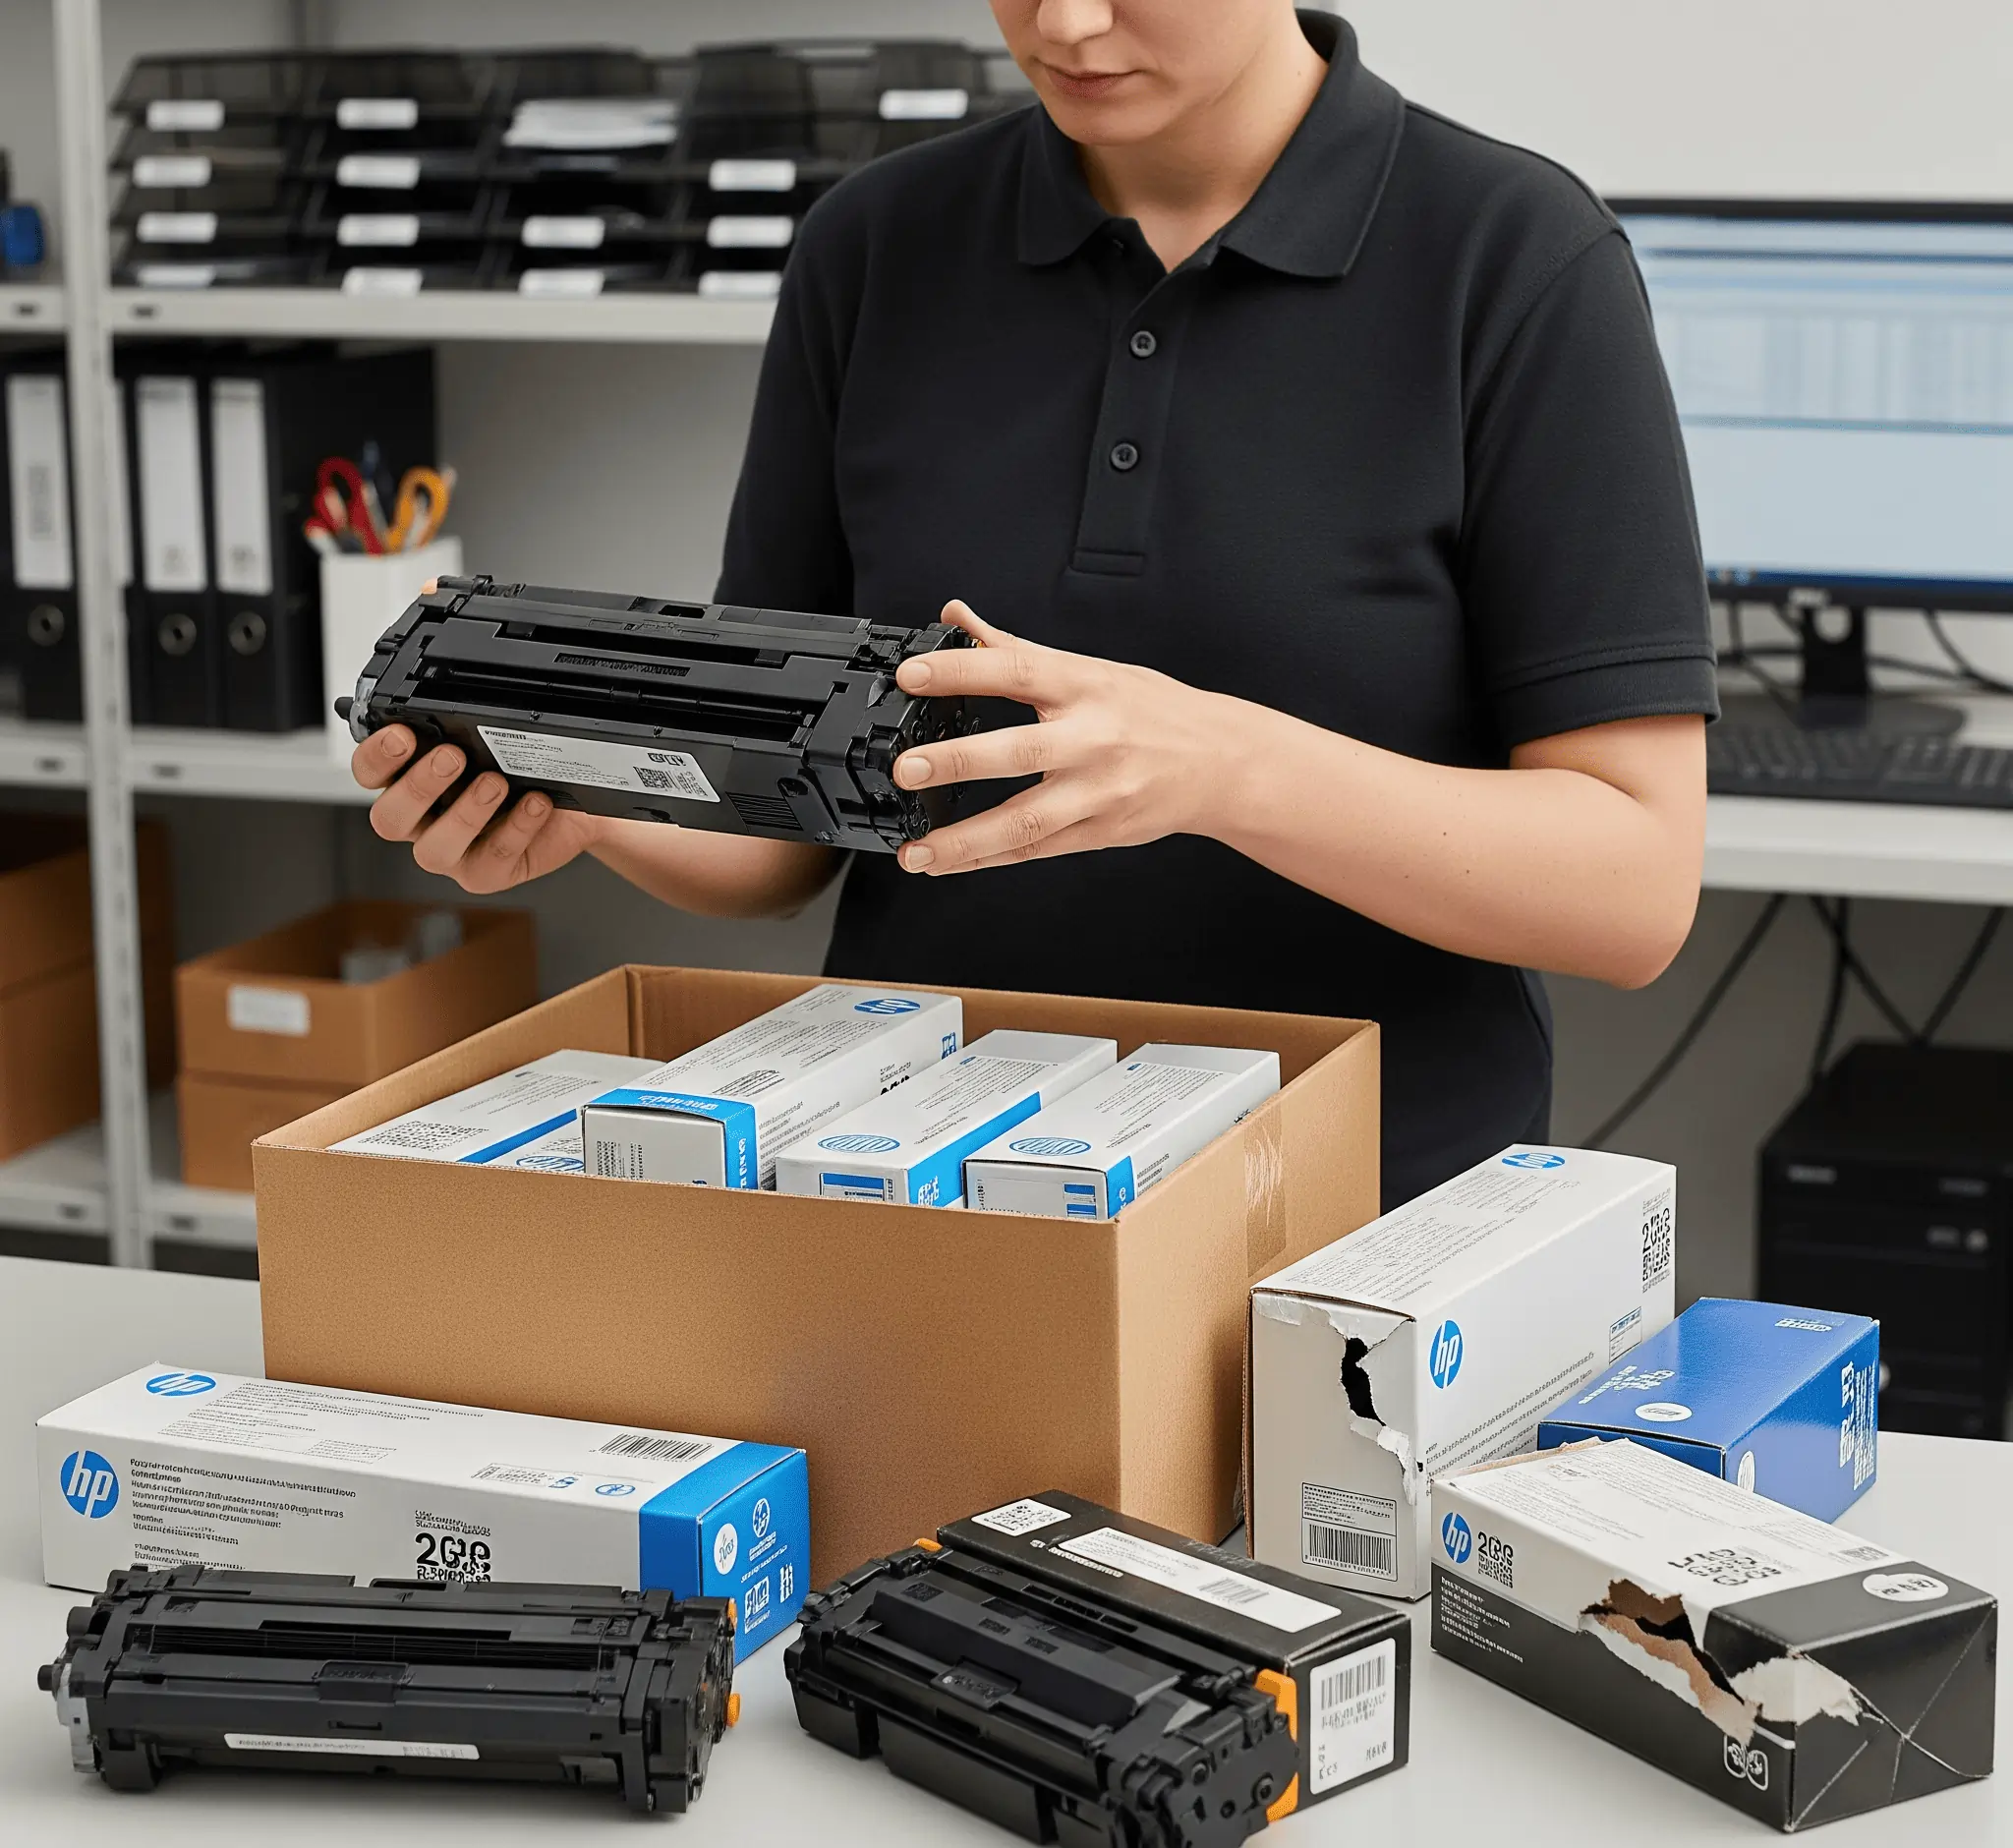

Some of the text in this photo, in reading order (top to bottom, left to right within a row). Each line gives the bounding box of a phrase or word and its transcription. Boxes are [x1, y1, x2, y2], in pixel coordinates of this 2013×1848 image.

[1432, 1321, 1462, 1388] hp
[146, 1373, 214, 1396] hp
[64, 1450, 116, 1519] hp
[1444, 1512, 1470, 1563] hp
